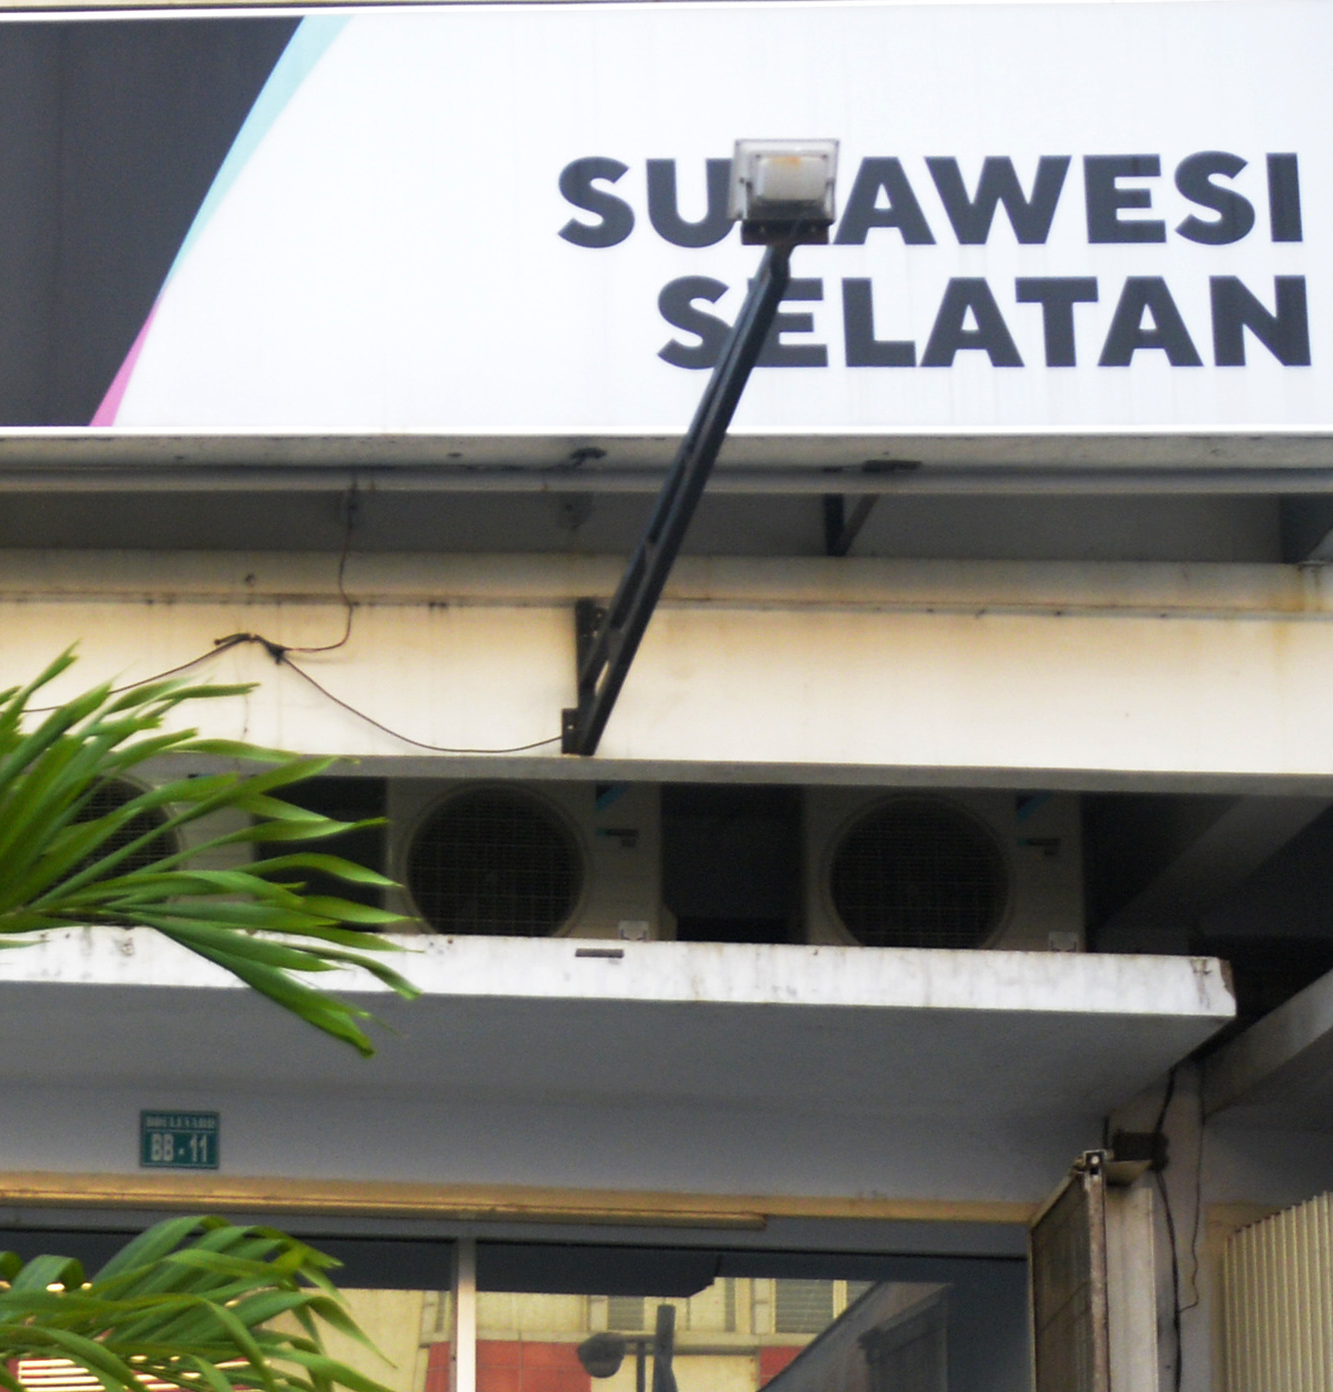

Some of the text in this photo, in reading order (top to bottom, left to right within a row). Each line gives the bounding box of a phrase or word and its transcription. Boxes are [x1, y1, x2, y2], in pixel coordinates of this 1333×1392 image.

[557, 151, 1303, 249] SUAWESI
[656, 274, 1312, 371] SELATAN
[190, 1133, 208, 1162] 11
